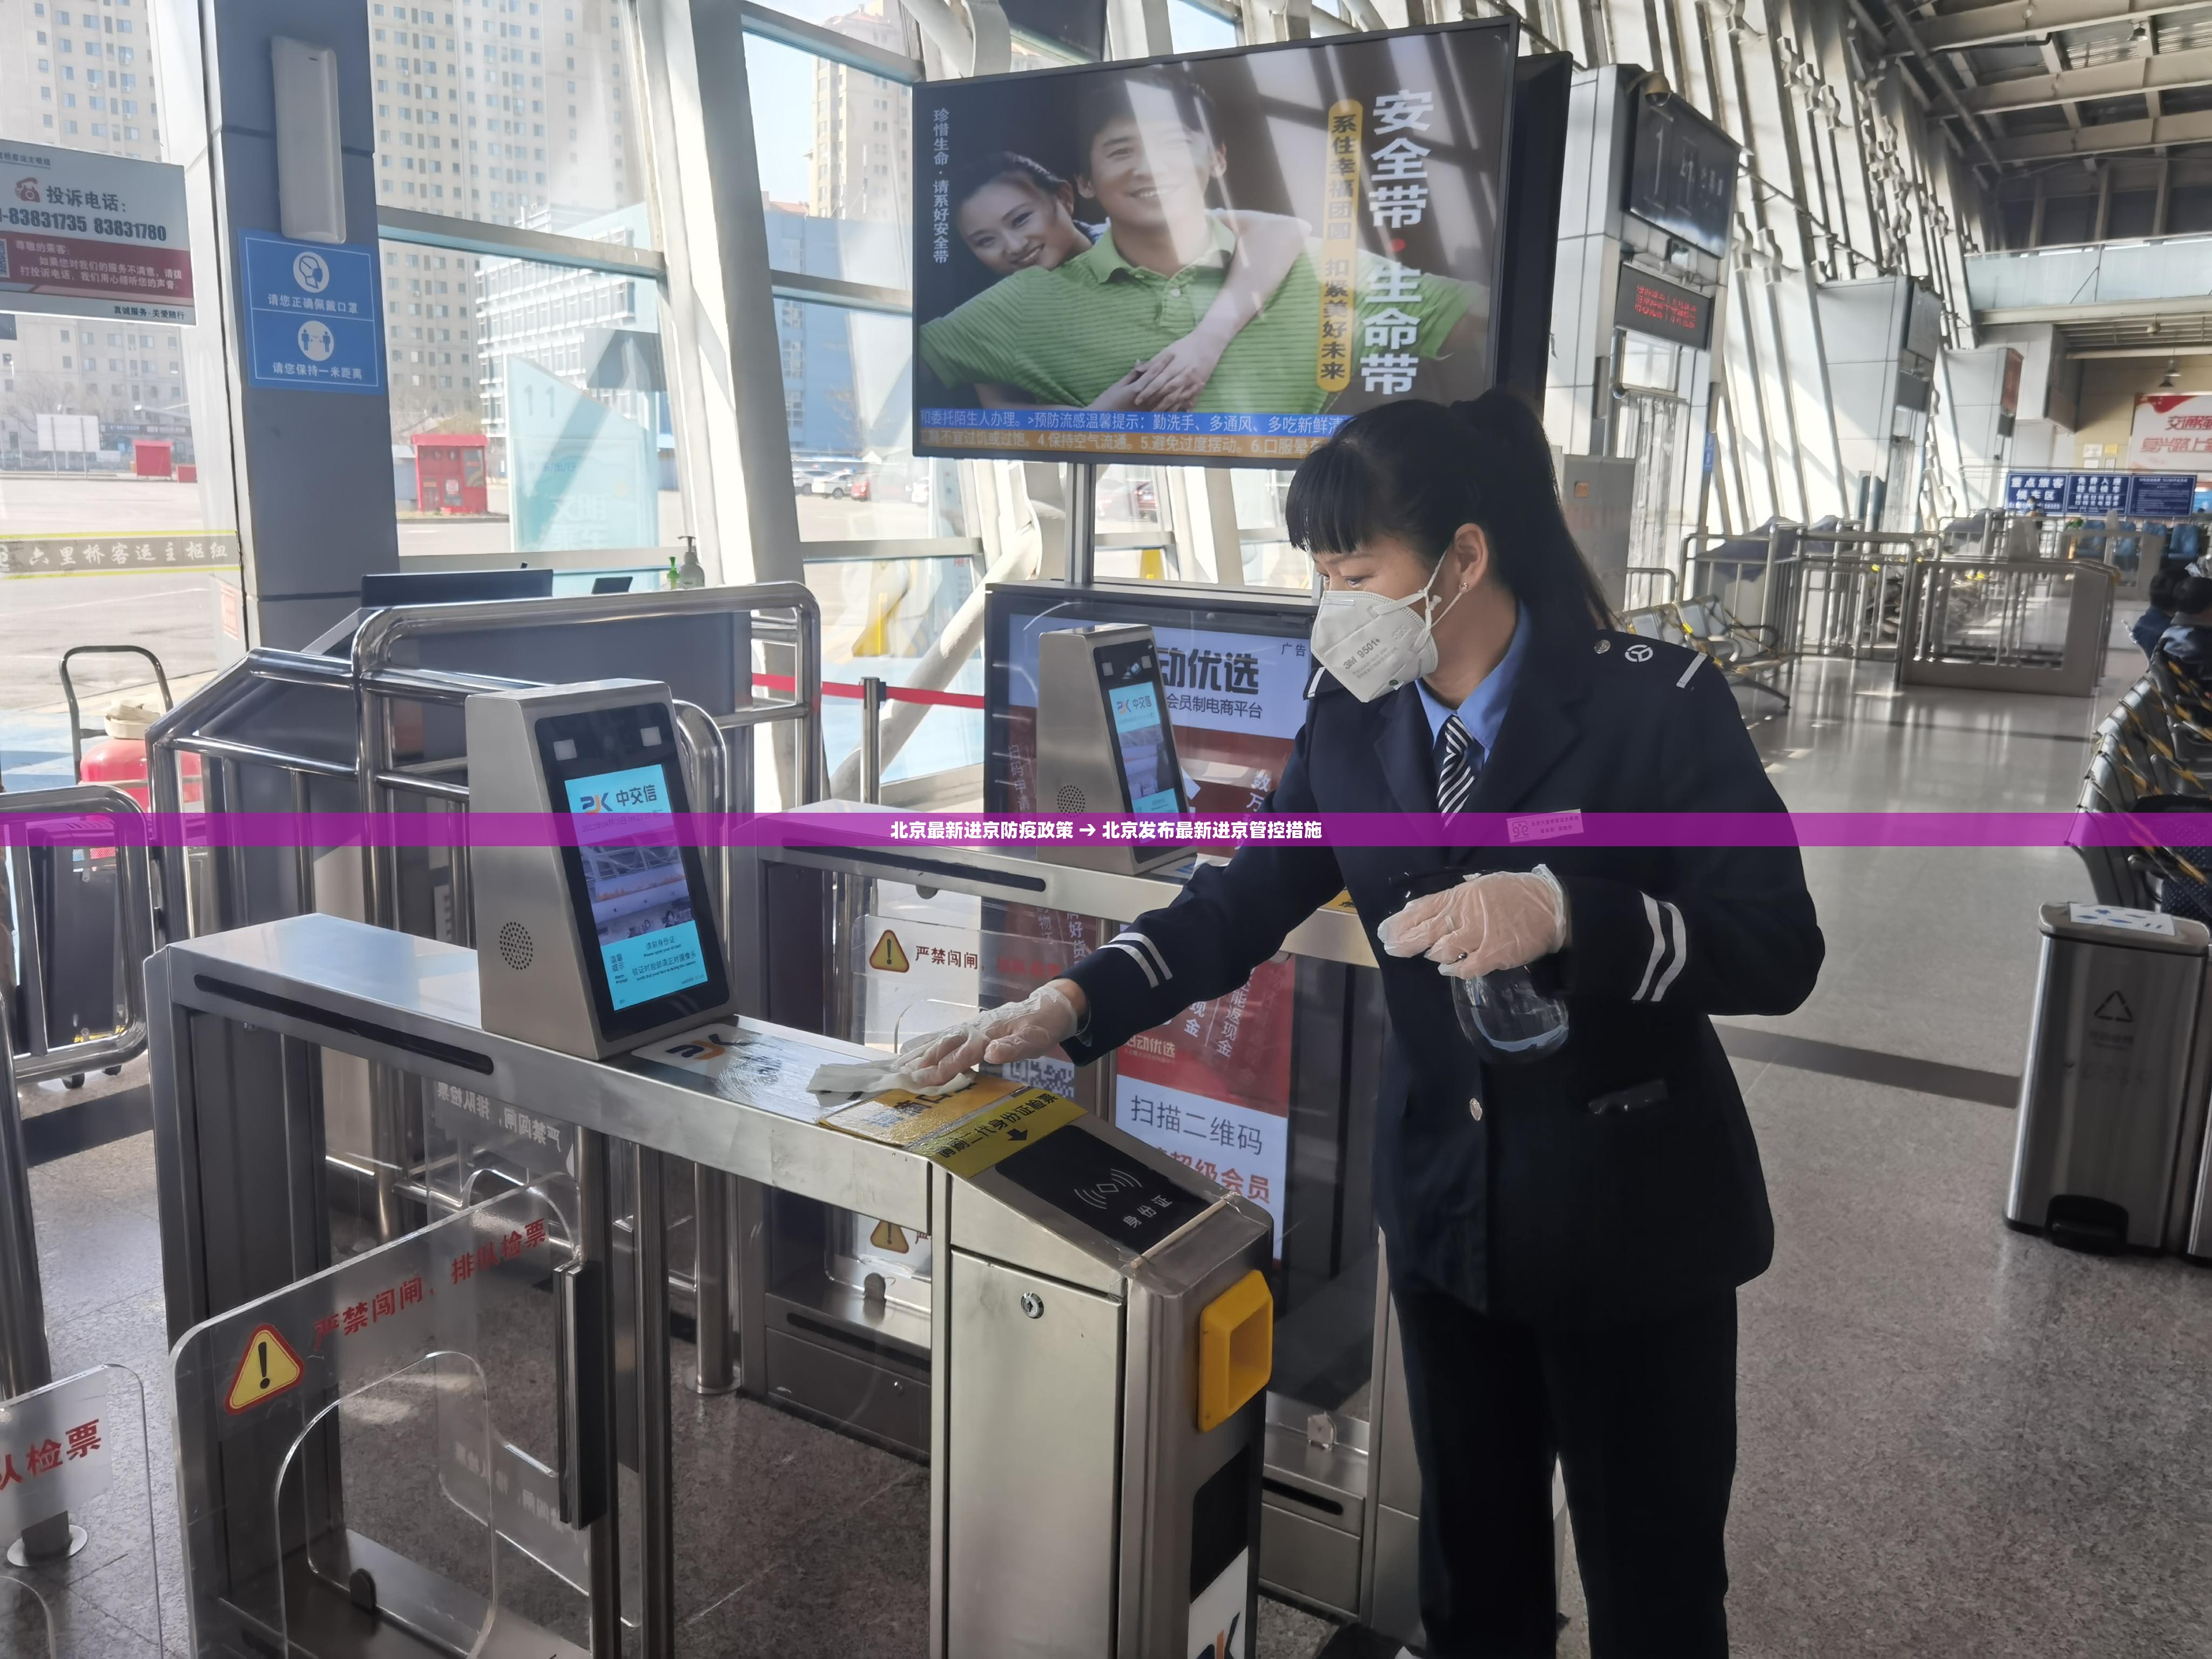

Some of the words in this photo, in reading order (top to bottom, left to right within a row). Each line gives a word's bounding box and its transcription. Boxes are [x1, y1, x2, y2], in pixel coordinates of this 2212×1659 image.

[933, 108, 949, 264] 珍惜生命·请系好安全带
[1327, 114, 1357, 240] 系住幸福团圆
[0, 207, 87, 232] -83831735
[94, 217, 167, 242] 83831780
[268, 293, 359, 314] 请您正确佩戴口罩
[1320, 258, 1349, 380] 扣紧美好未来
[273, 361, 362, 380] 请您保持一米距离
[1281, 642, 1306, 657] 广告
[1343, 656, 1358, 670] 3M
[1166, 693, 1263, 719] 会员制电商平台
[616, 784, 657, 807] 中交信
[915, 946, 978, 969] 严禁闯闸
[1131, 1095, 1263, 1156] 扫描二维码
[1122, 1194, 1172, 1229] 身份证
